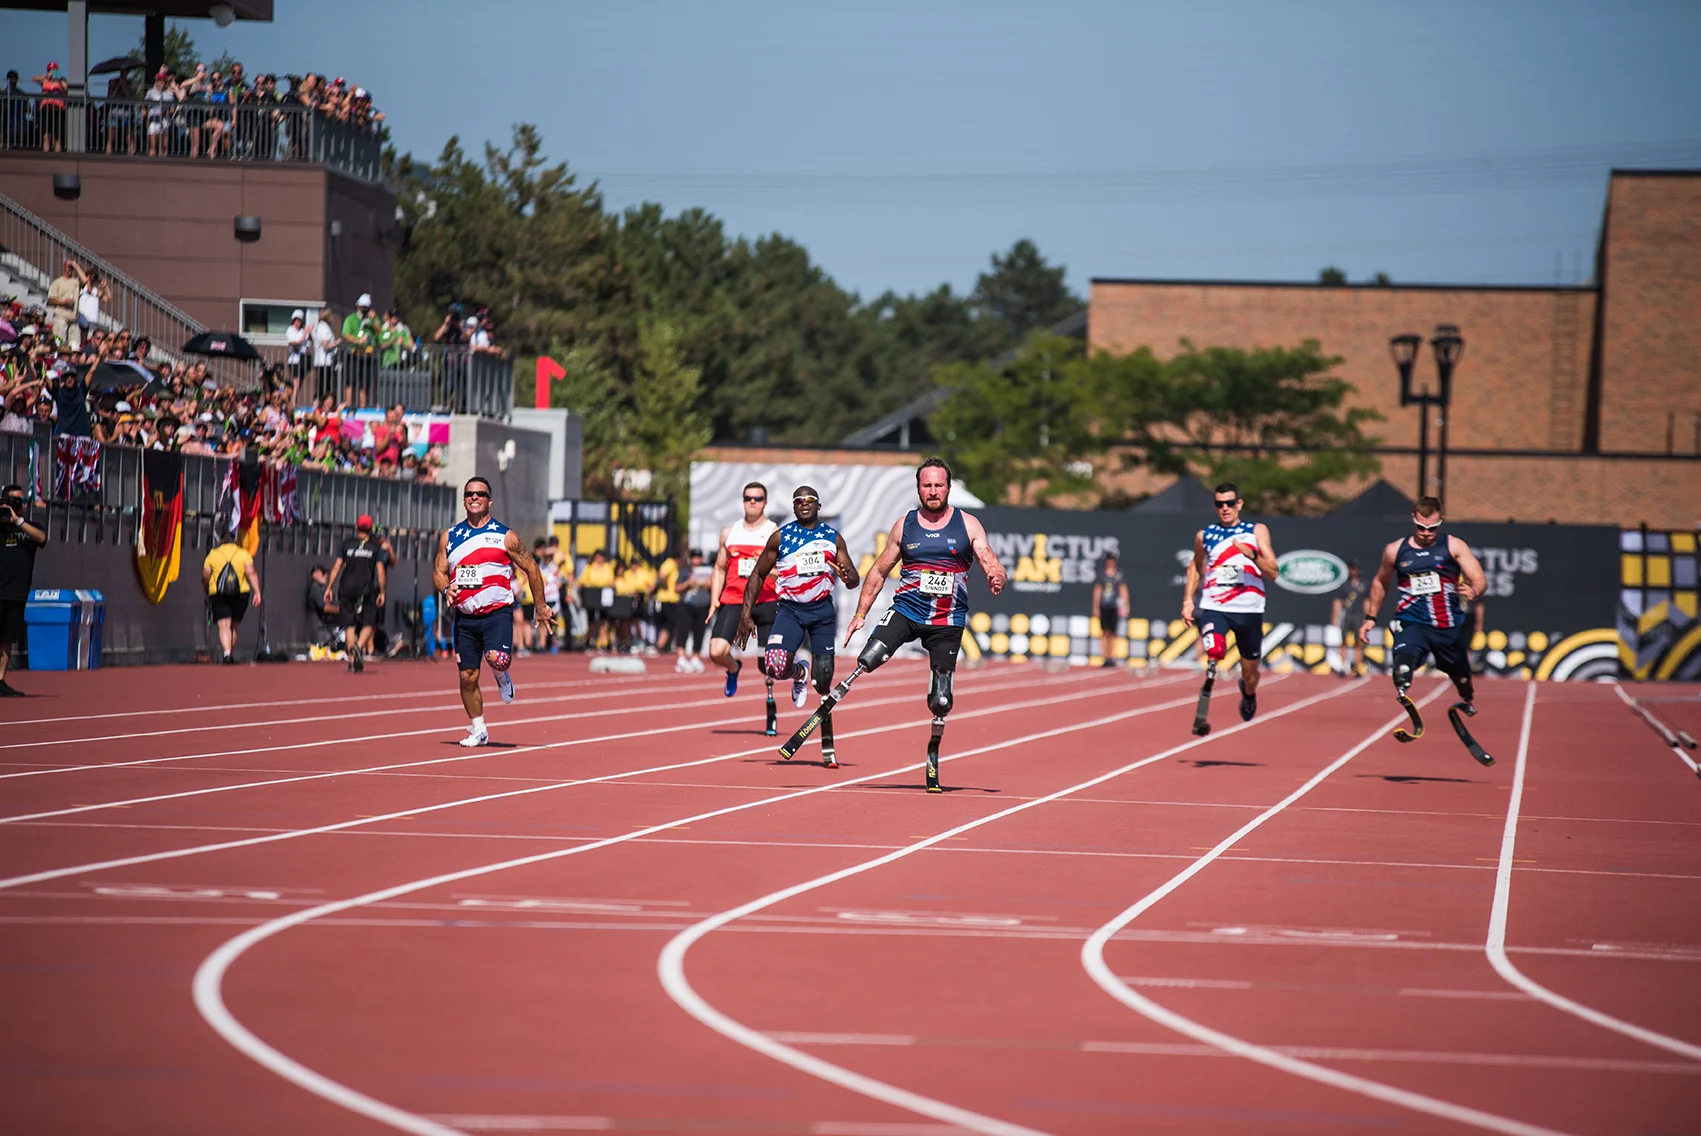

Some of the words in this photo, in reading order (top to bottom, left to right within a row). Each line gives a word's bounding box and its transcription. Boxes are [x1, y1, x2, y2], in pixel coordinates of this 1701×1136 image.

[460, 569, 477, 578] 298
[927, 576, 947, 587] 246
[880, 610, 891, 624] 4
